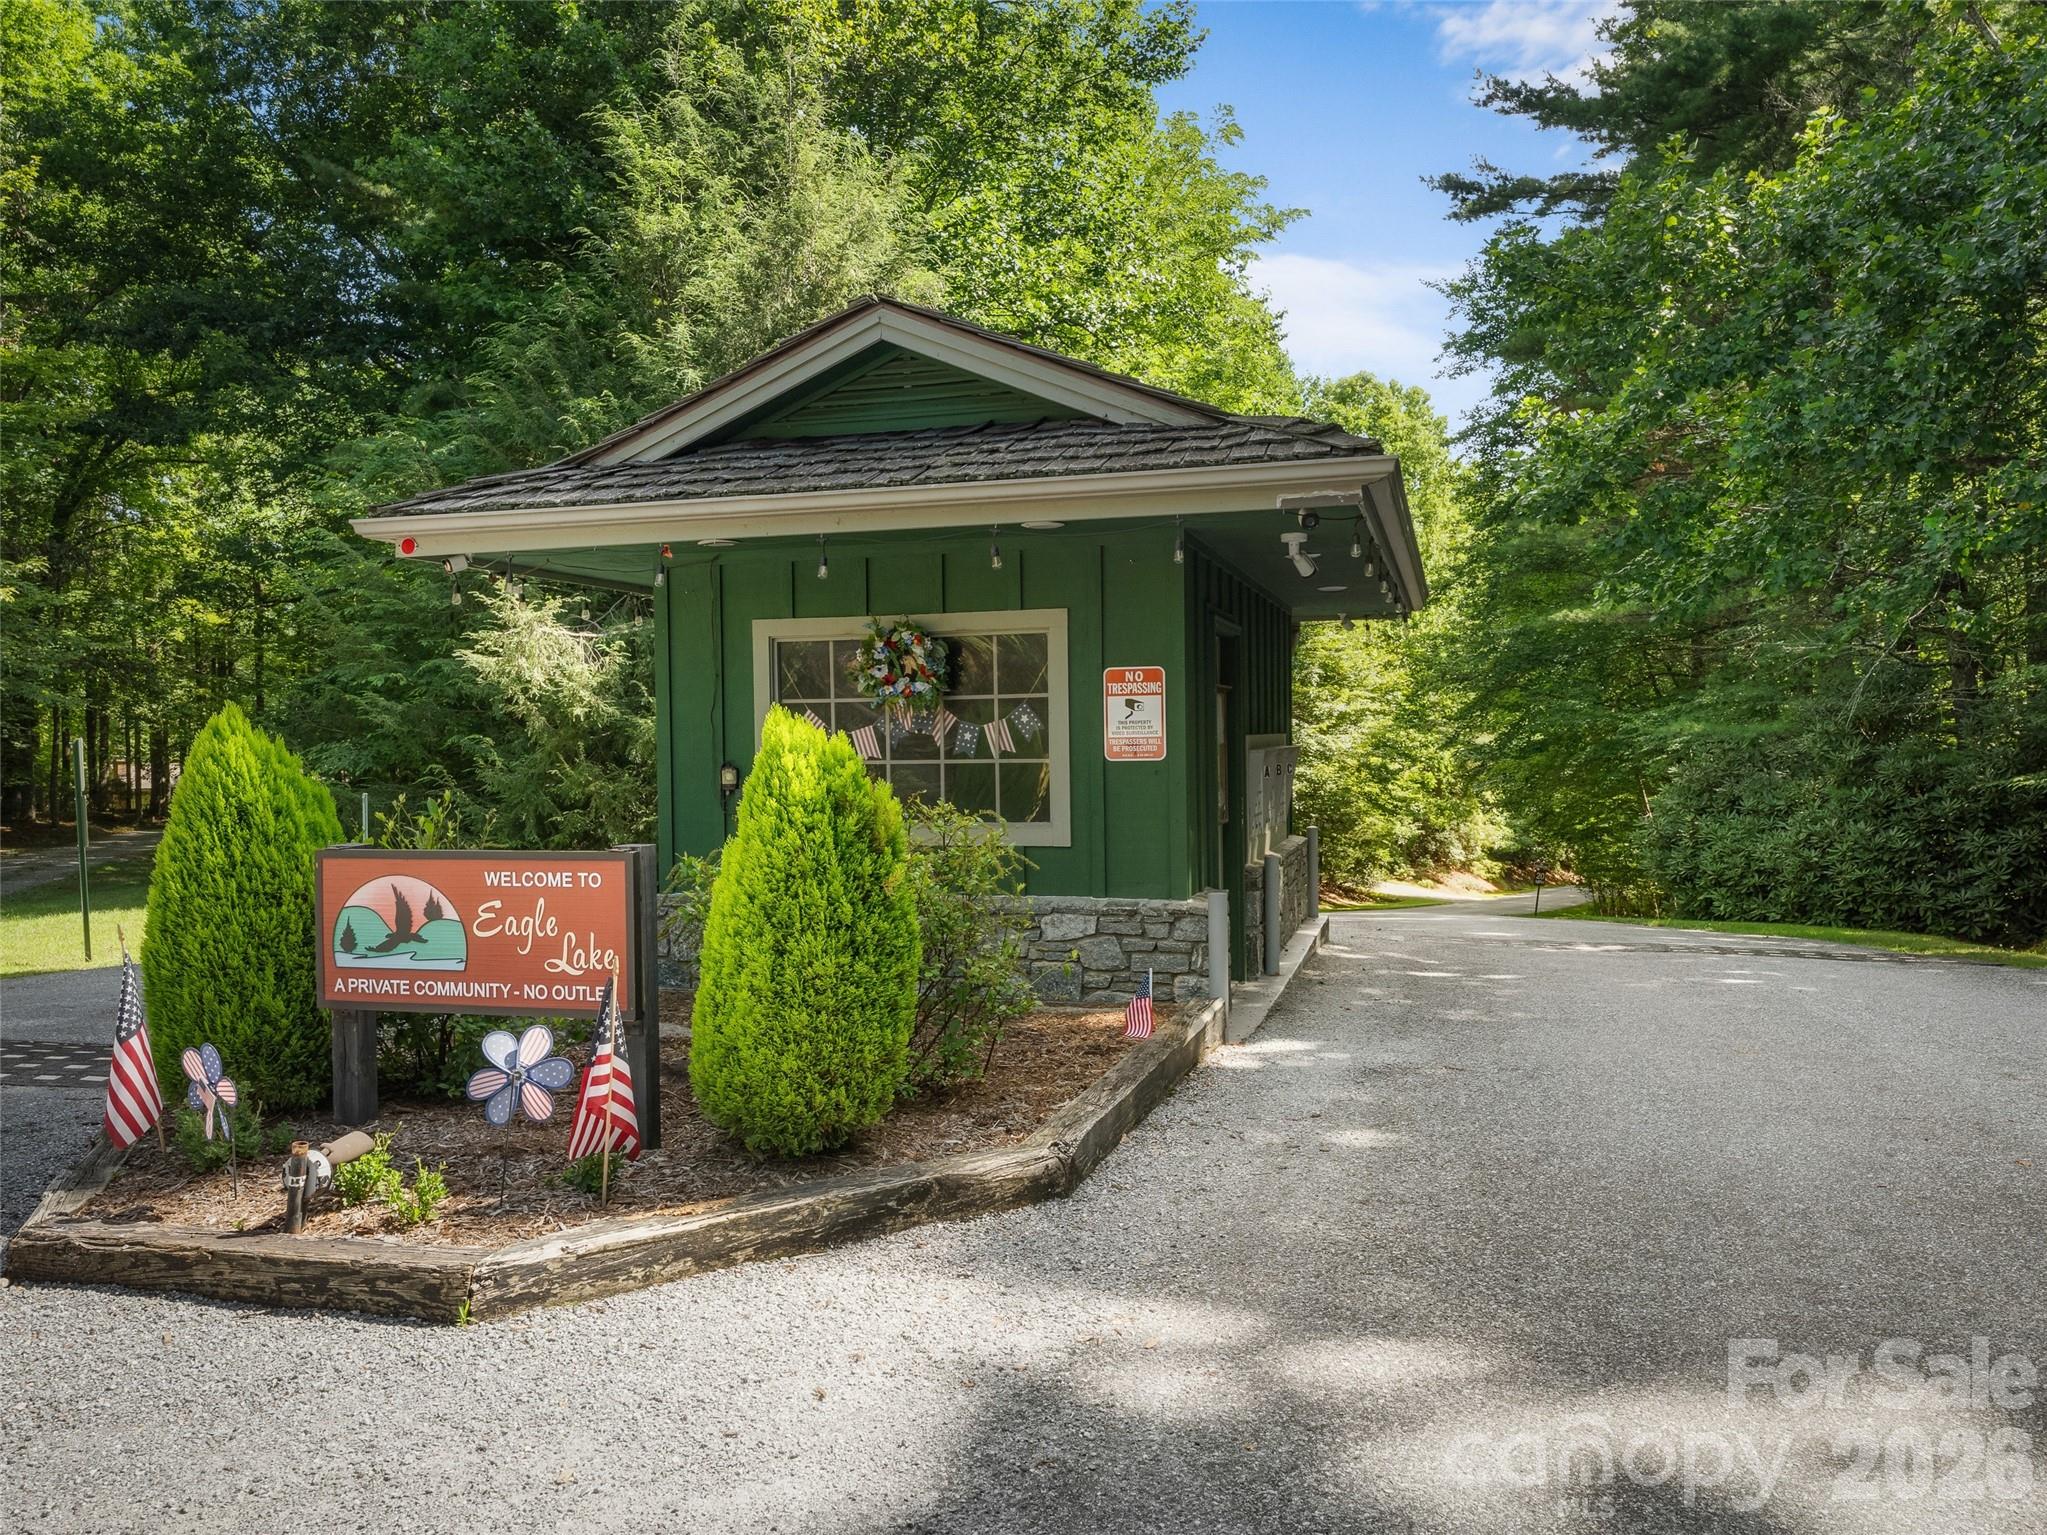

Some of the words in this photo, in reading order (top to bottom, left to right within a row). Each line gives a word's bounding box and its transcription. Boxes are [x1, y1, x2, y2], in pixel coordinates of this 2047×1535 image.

[1125, 670, 1144, 682] NO
[1107, 681, 1162, 695] TRESPASSING
[484, 871, 573, 888] WELCOME
[577, 871, 602, 889] TO
[1535, 872, 1545, 880] 20
[472, 896, 559, 955] Eagle
[544, 931, 616, 976] Lake
[334, 977, 346, 993] A
[348, 978, 410, 995] PRIVATE
[413, 980, 512, 1000] COMMUNITY
[523, 984, 548, 1000] NO
[552, 985, 606, 1002] OUTLE
